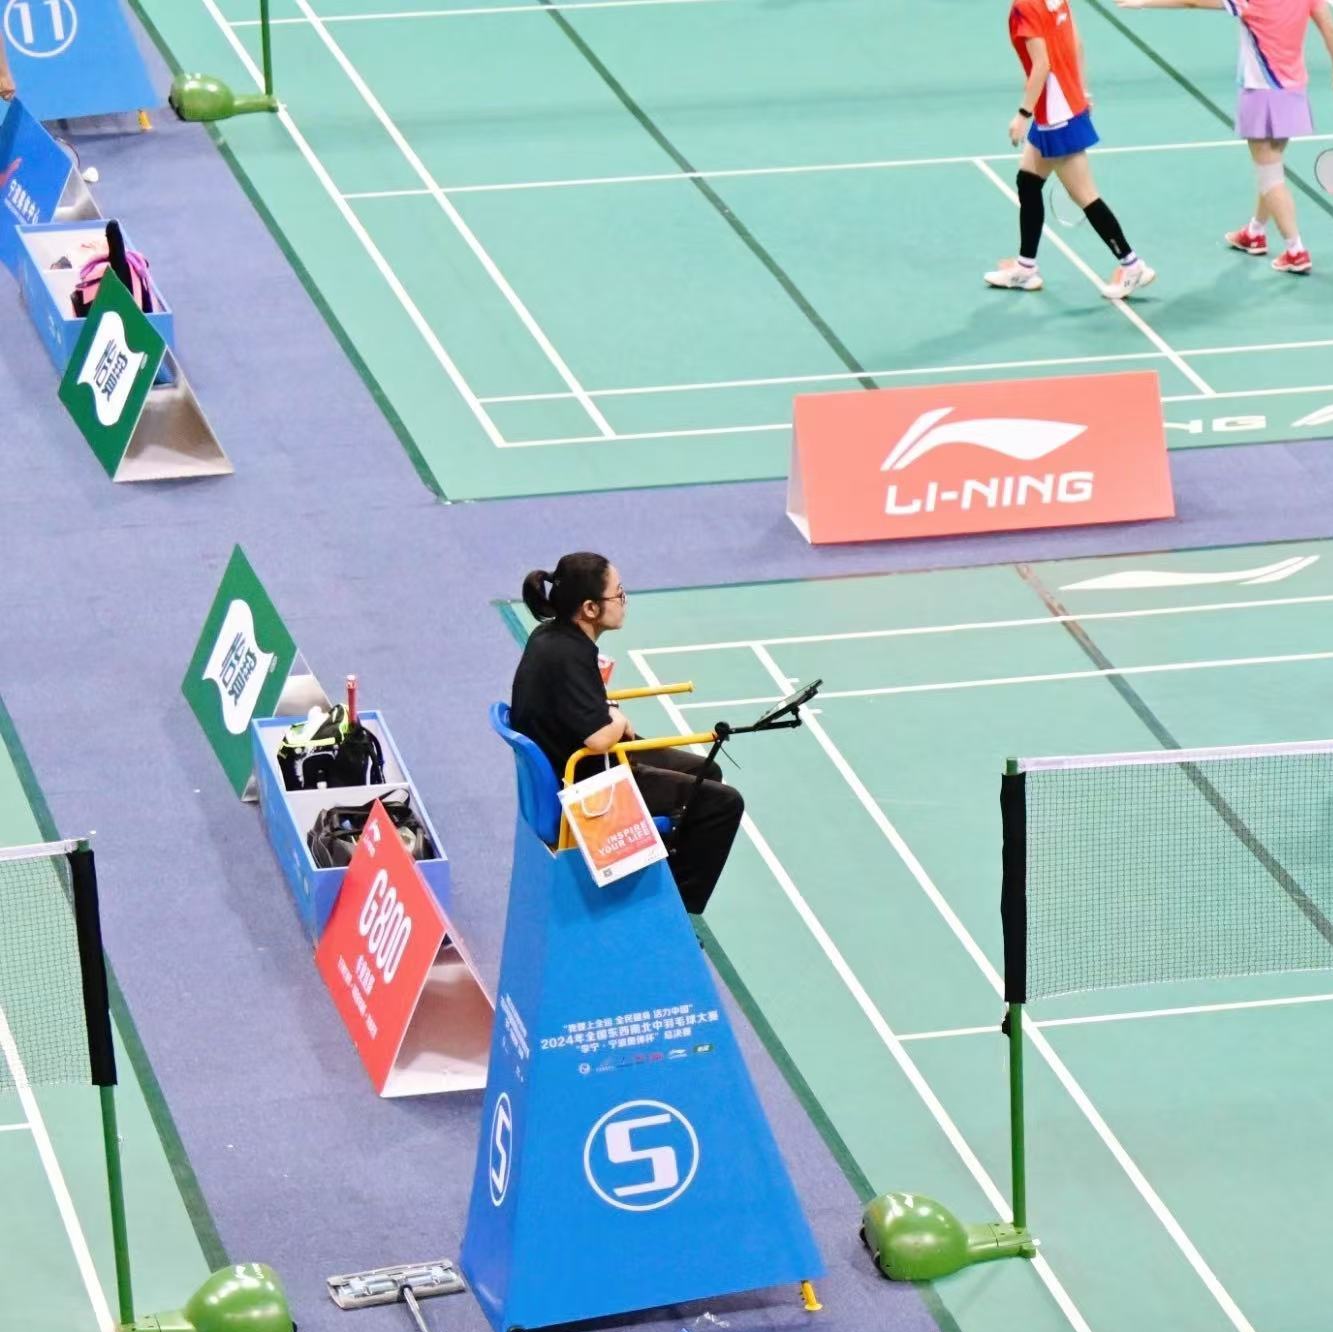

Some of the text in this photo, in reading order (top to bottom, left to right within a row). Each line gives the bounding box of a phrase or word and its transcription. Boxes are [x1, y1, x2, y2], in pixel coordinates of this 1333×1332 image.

[14, 0, 65, 44] 11
[885, 471, 1094, 515] LI-NING
[359, 868, 412, 985] G800
[603, 1113, 679, 1197] 5
